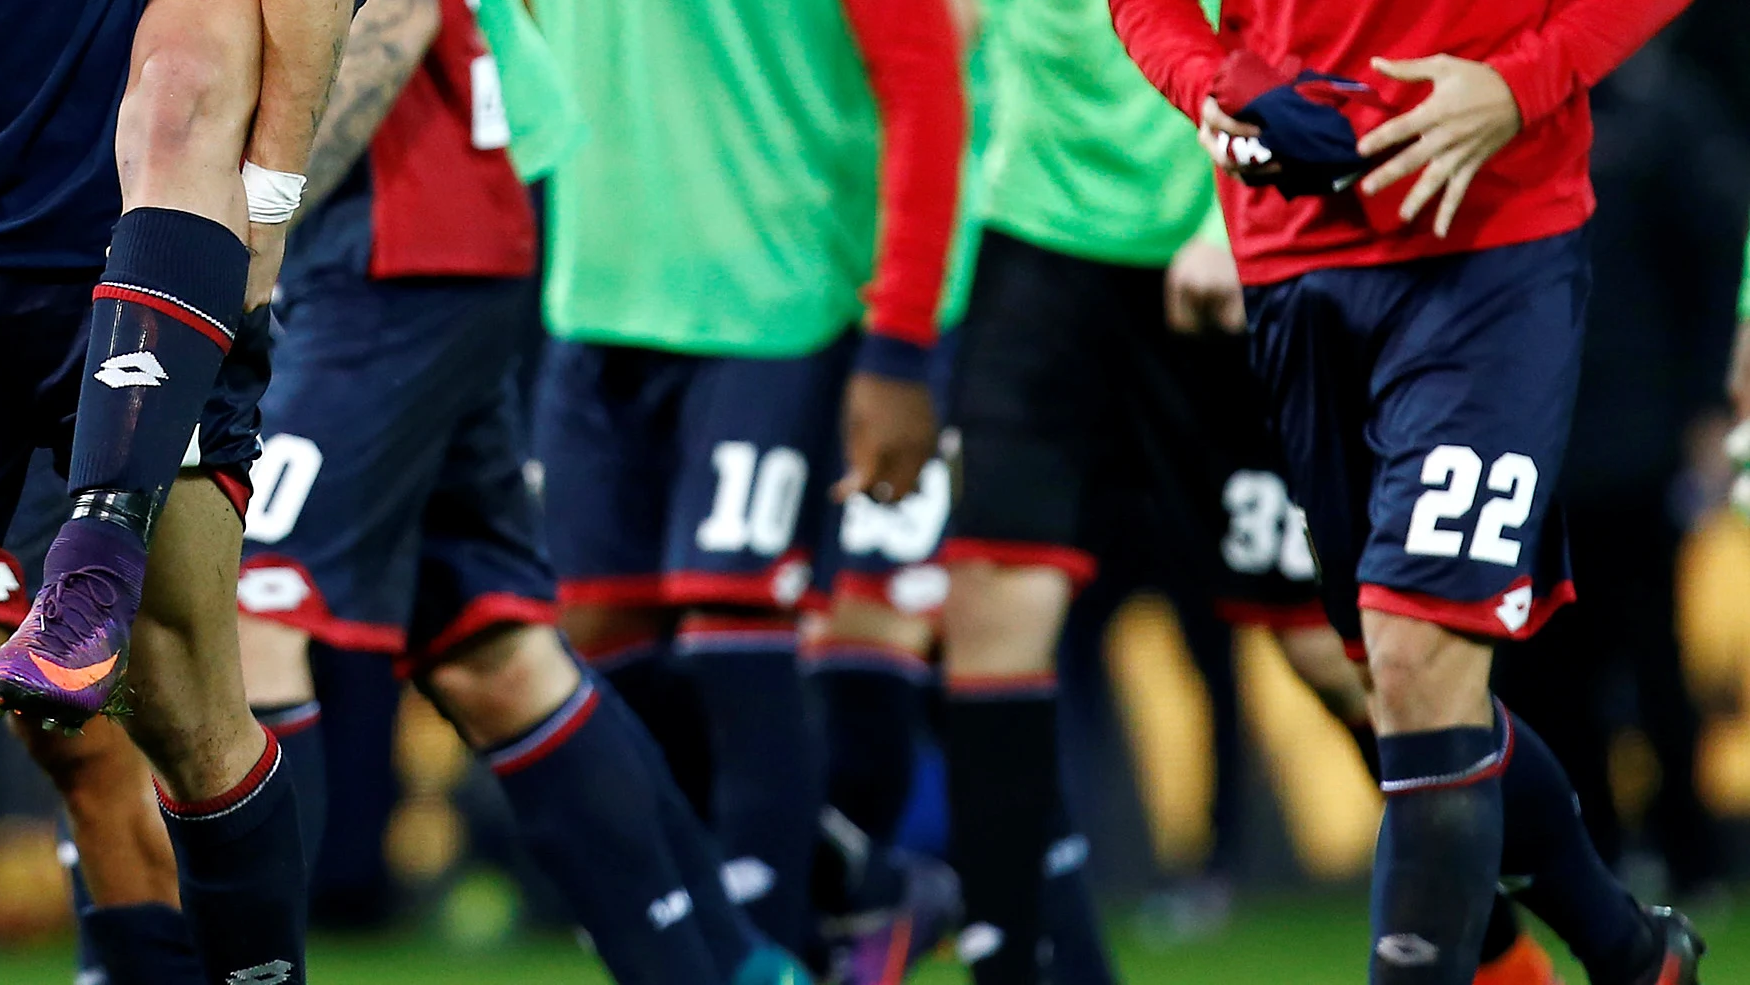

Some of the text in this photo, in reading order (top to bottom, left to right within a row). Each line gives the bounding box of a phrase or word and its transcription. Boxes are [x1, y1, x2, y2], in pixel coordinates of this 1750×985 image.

[243, 432, 324, 545] 0
[696, 440, 809, 558] 10
[1404, 444, 1539, 567] 22
